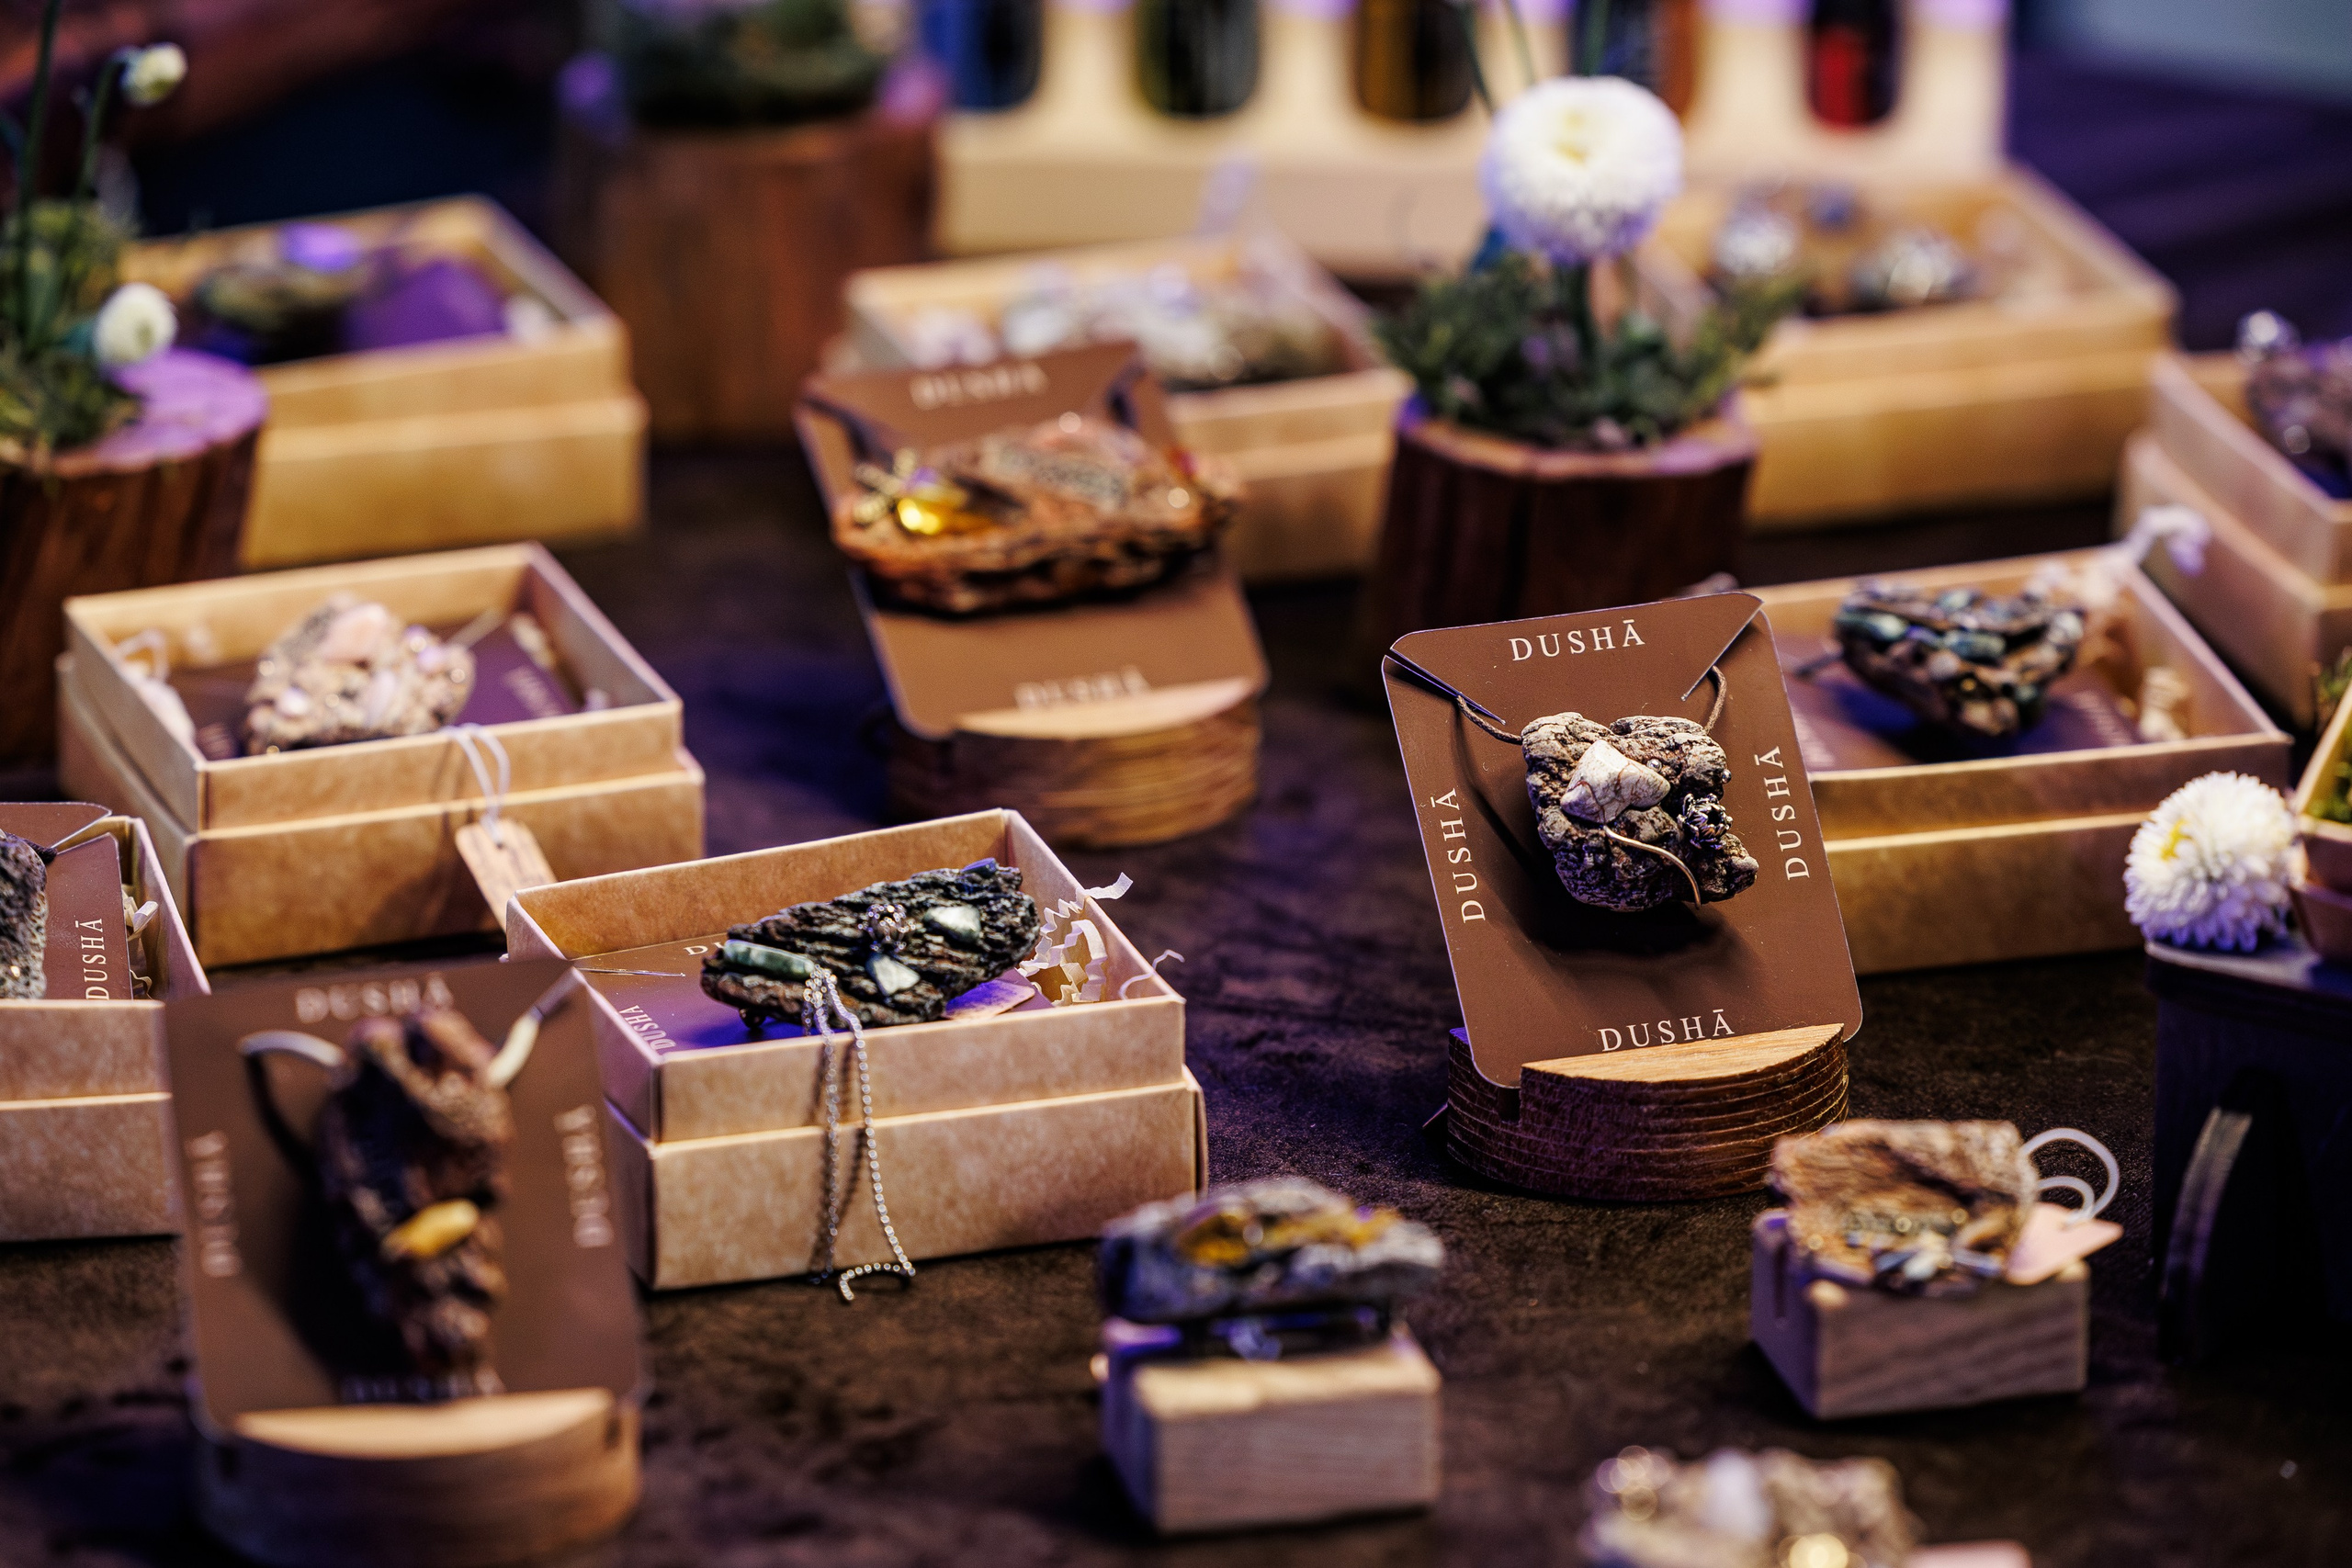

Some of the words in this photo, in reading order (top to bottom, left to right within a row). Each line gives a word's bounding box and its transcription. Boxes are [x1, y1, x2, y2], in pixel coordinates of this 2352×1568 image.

[1509, 619, 1645, 661] DUSHĀ
[1754, 746, 1810, 881] DUSHĀ
[1430, 787, 1486, 924] DUSHĀ
[74, 918, 109, 1000] DUSHĀ
[1598, 1009, 1735, 1052] DUSHĀ
